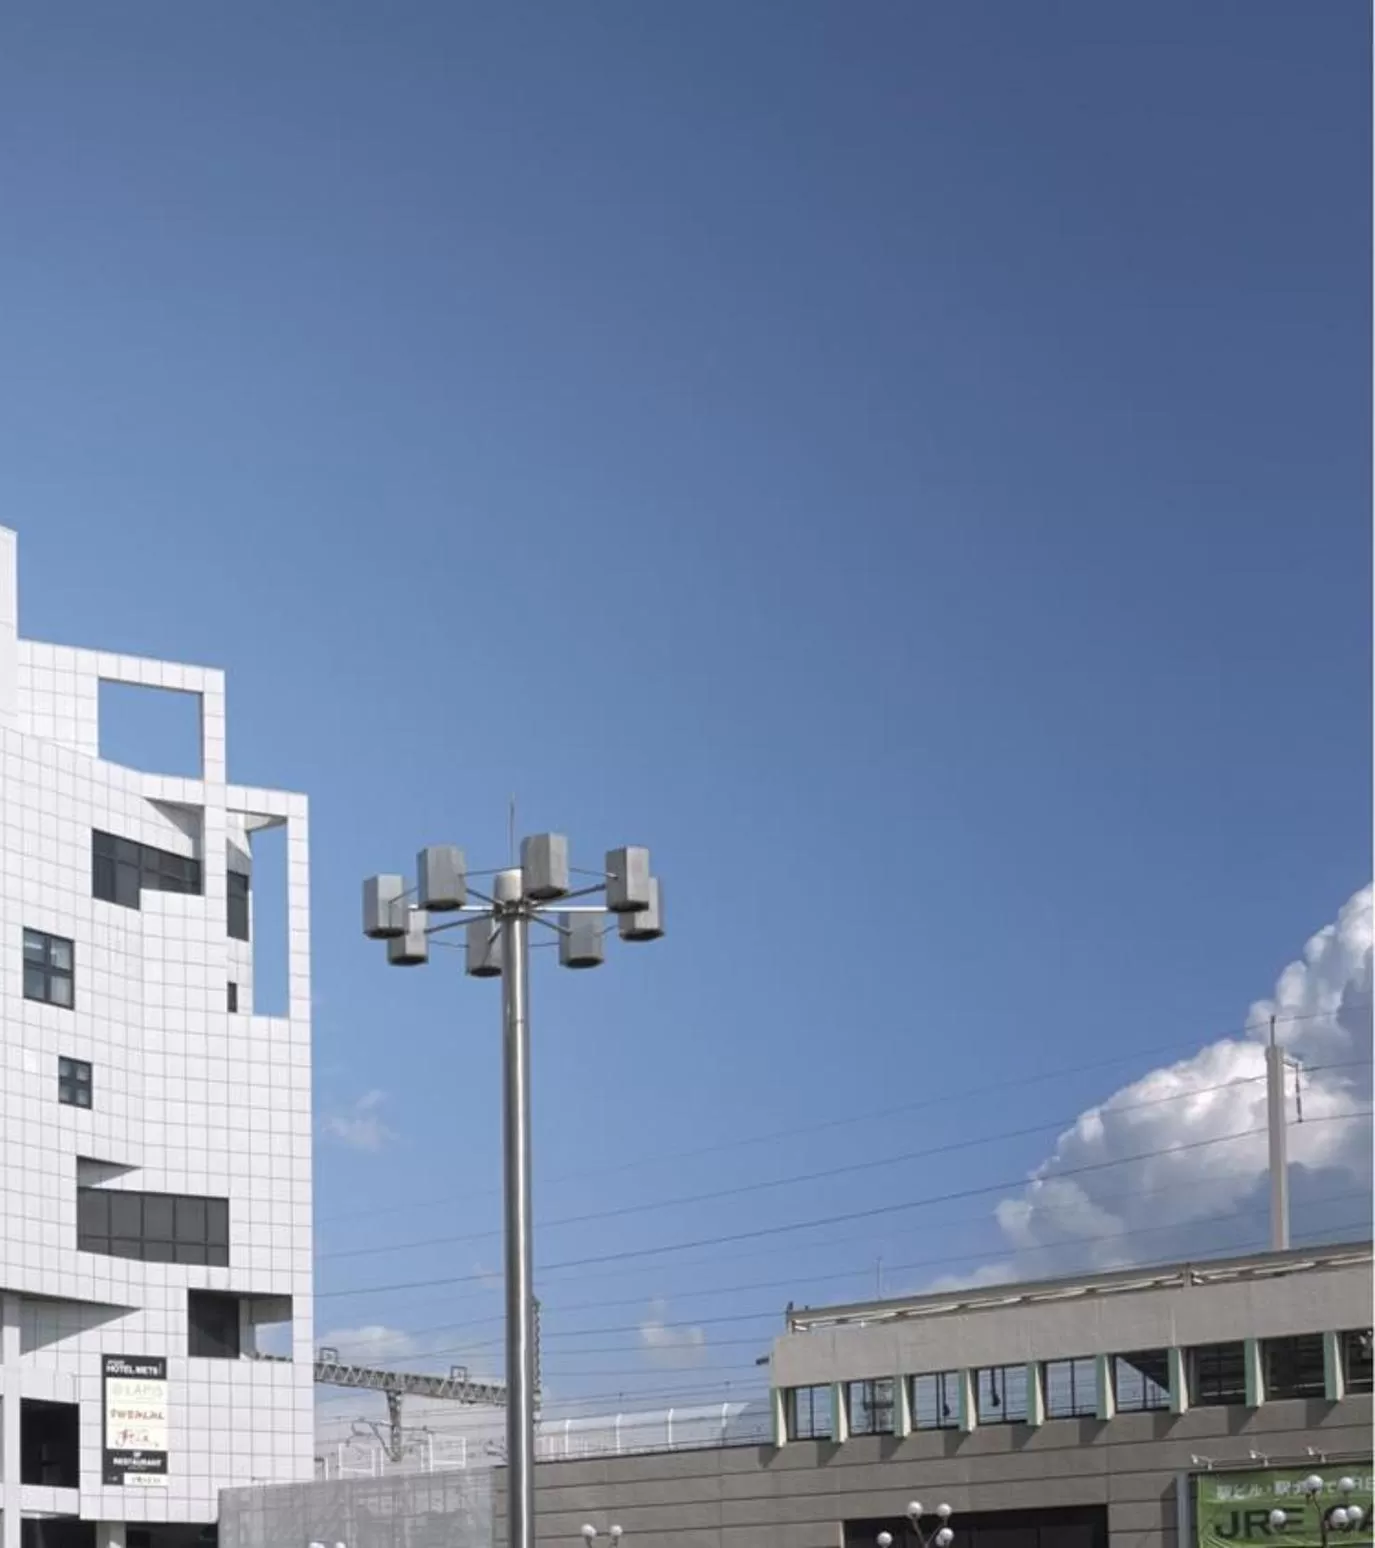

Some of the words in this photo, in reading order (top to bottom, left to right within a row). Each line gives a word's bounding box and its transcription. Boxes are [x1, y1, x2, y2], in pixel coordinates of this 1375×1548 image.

[106, 1365, 133, 1375] HOTEL
[135, 1365, 159, 1377] METS
[113, 1457, 162, 1467] RESTAURANT
[1215, 1507, 1305, 1539] JRE
